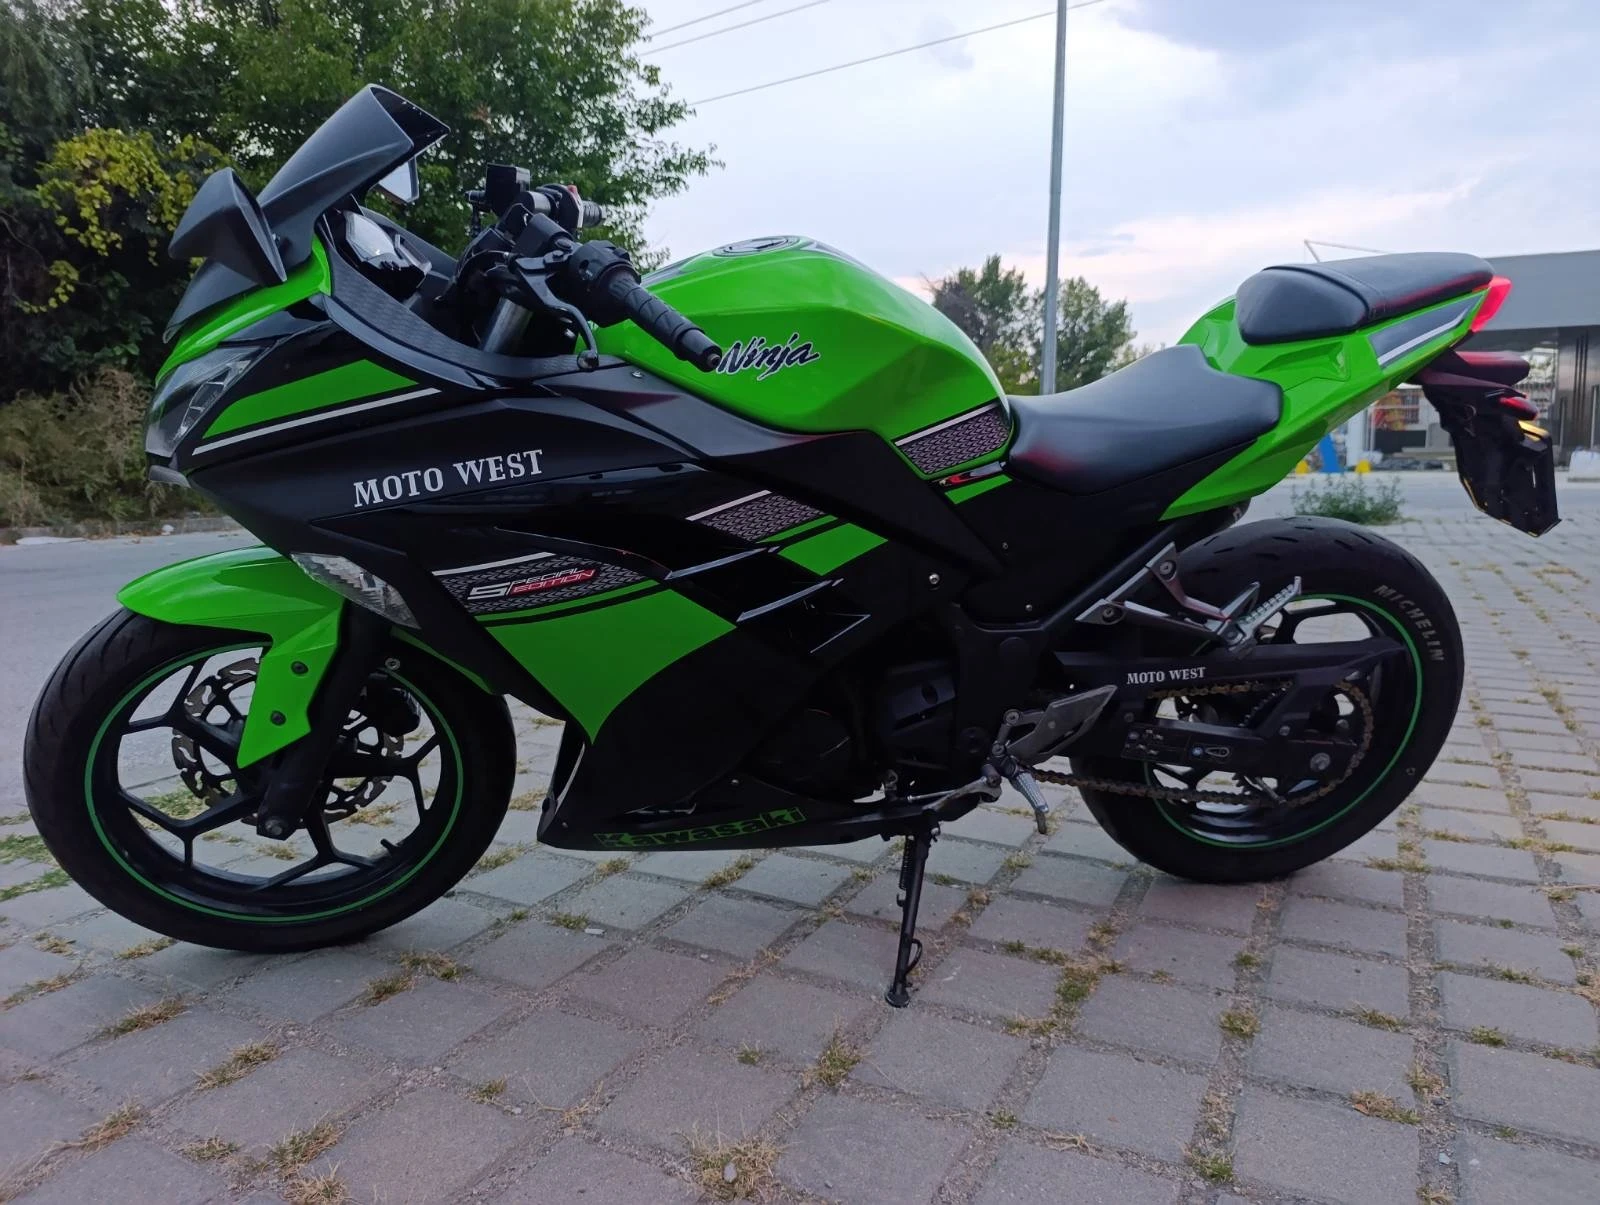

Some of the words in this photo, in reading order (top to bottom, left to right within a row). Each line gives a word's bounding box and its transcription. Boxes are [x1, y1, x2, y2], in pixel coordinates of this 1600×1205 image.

[715, 332, 820, 381] Ninja
[353, 467, 444, 508] MOTO
[452, 449, 543, 486] WEST
[467, 567, 585, 600] SPECIAL
[512, 569, 596, 594] EDITION
[1373, 584, 1445, 661] MICHELIN
[1126, 670, 1166, 685] MOTO
[1168, 666, 1207, 681] WEST
[593, 807, 807, 848] Kawasaki
